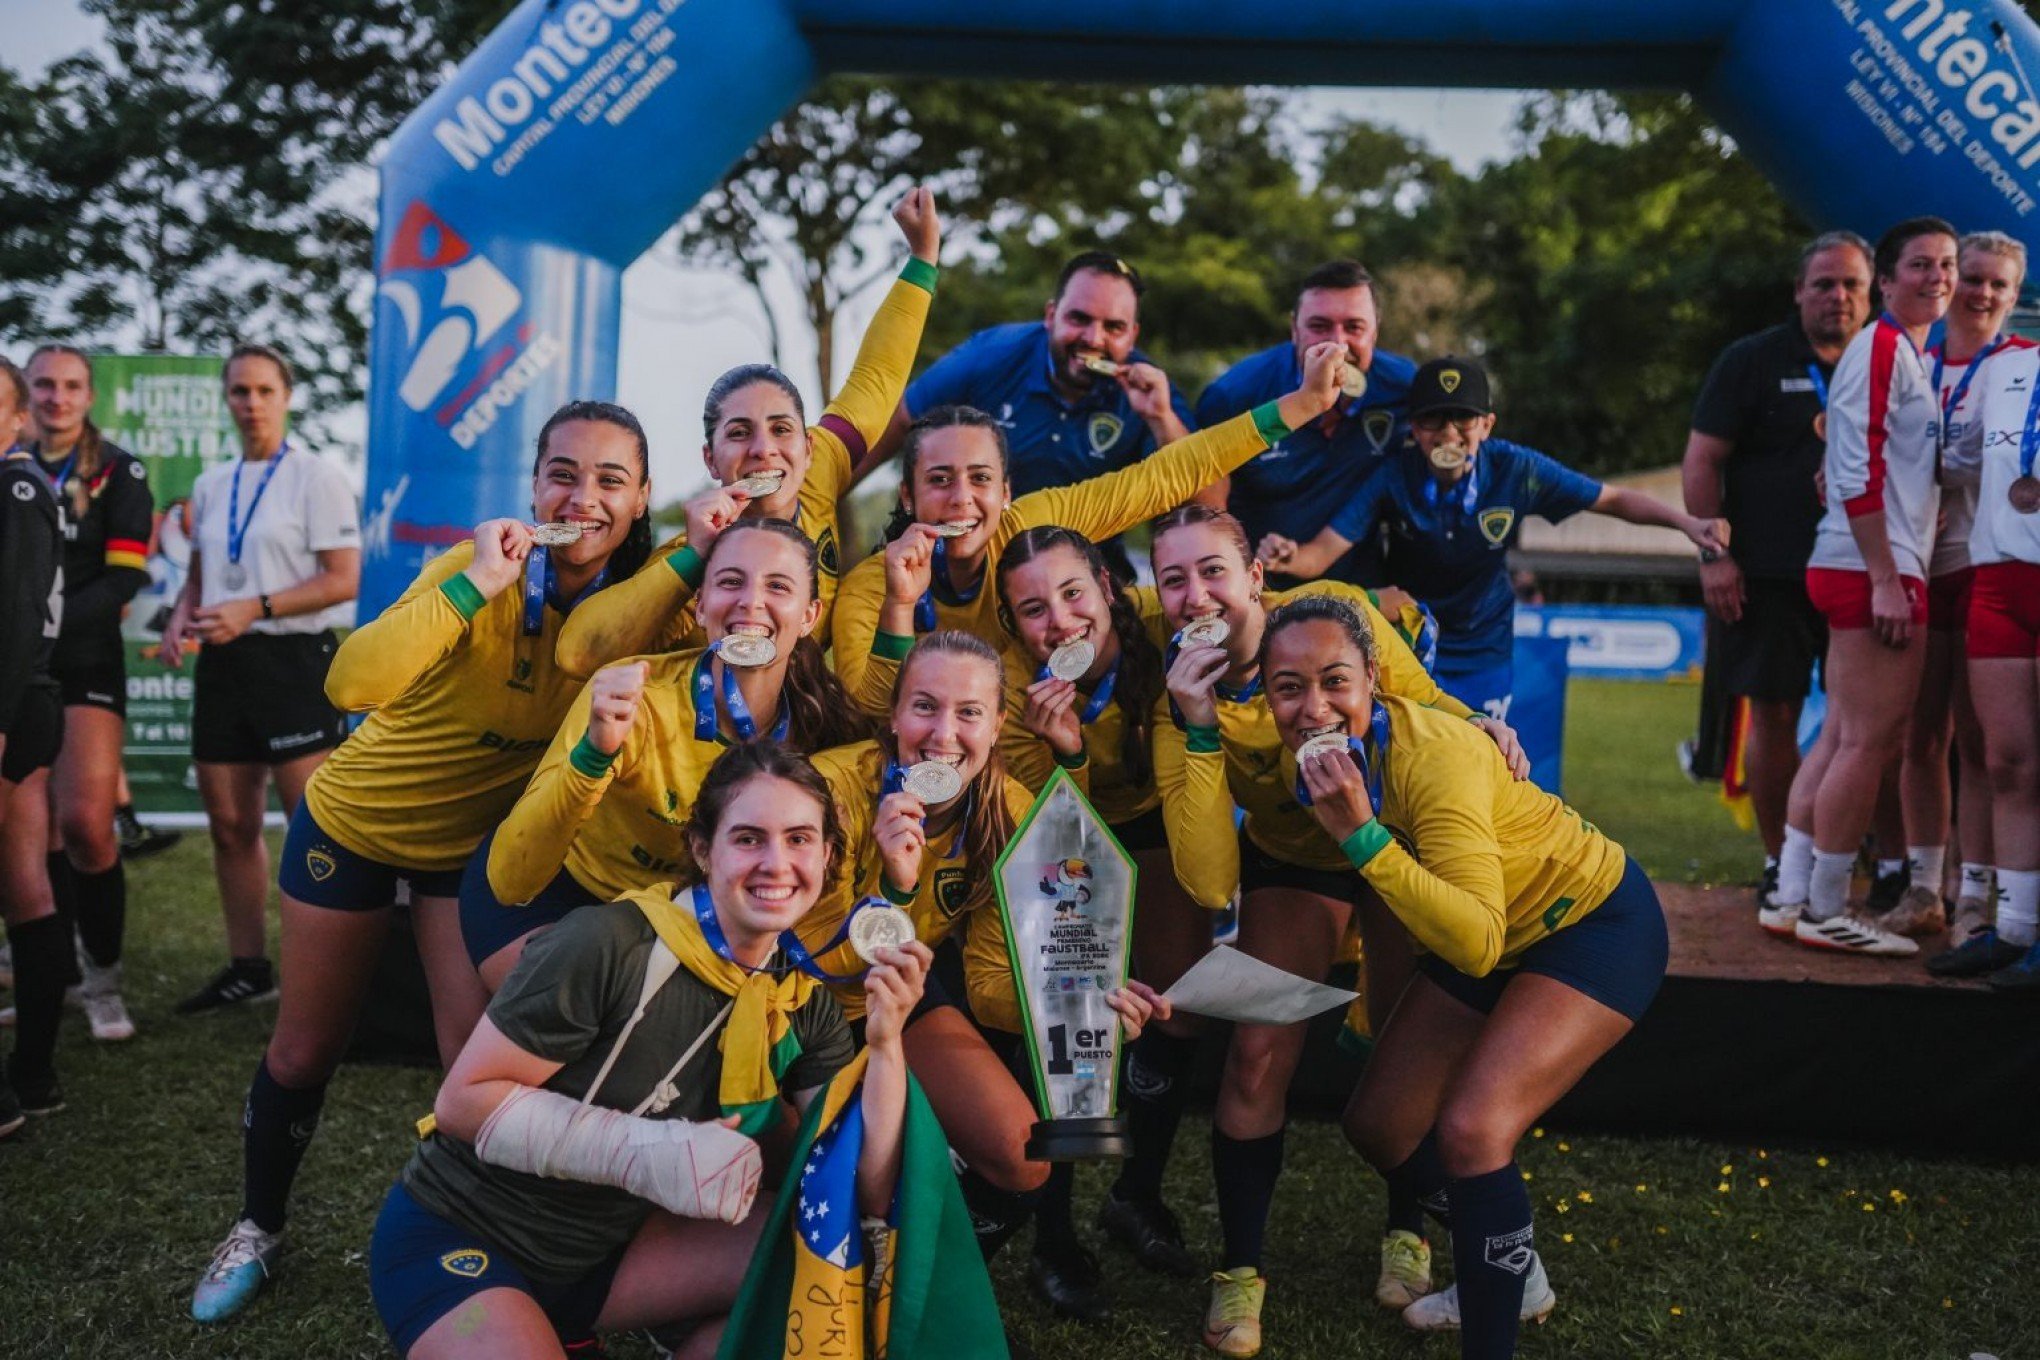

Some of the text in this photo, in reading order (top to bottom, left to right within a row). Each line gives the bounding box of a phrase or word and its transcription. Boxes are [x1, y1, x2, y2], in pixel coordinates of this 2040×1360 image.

[1850, 48, 1884, 83] LEY
[493, 117, 554, 177] CAPITAL
[549, 38, 634, 121] PROVINCIAL
[1845, 78, 1915, 155] MISIONES
[1857, 19, 1939, 114] PROVINCIAL
[1936, 108, 1968, 146] DEL
[1964, 139, 2035, 217] DEPORTE
[115, 387, 230, 416] MUNDI
[1073, 1051, 1113, 1059] PUESTO
